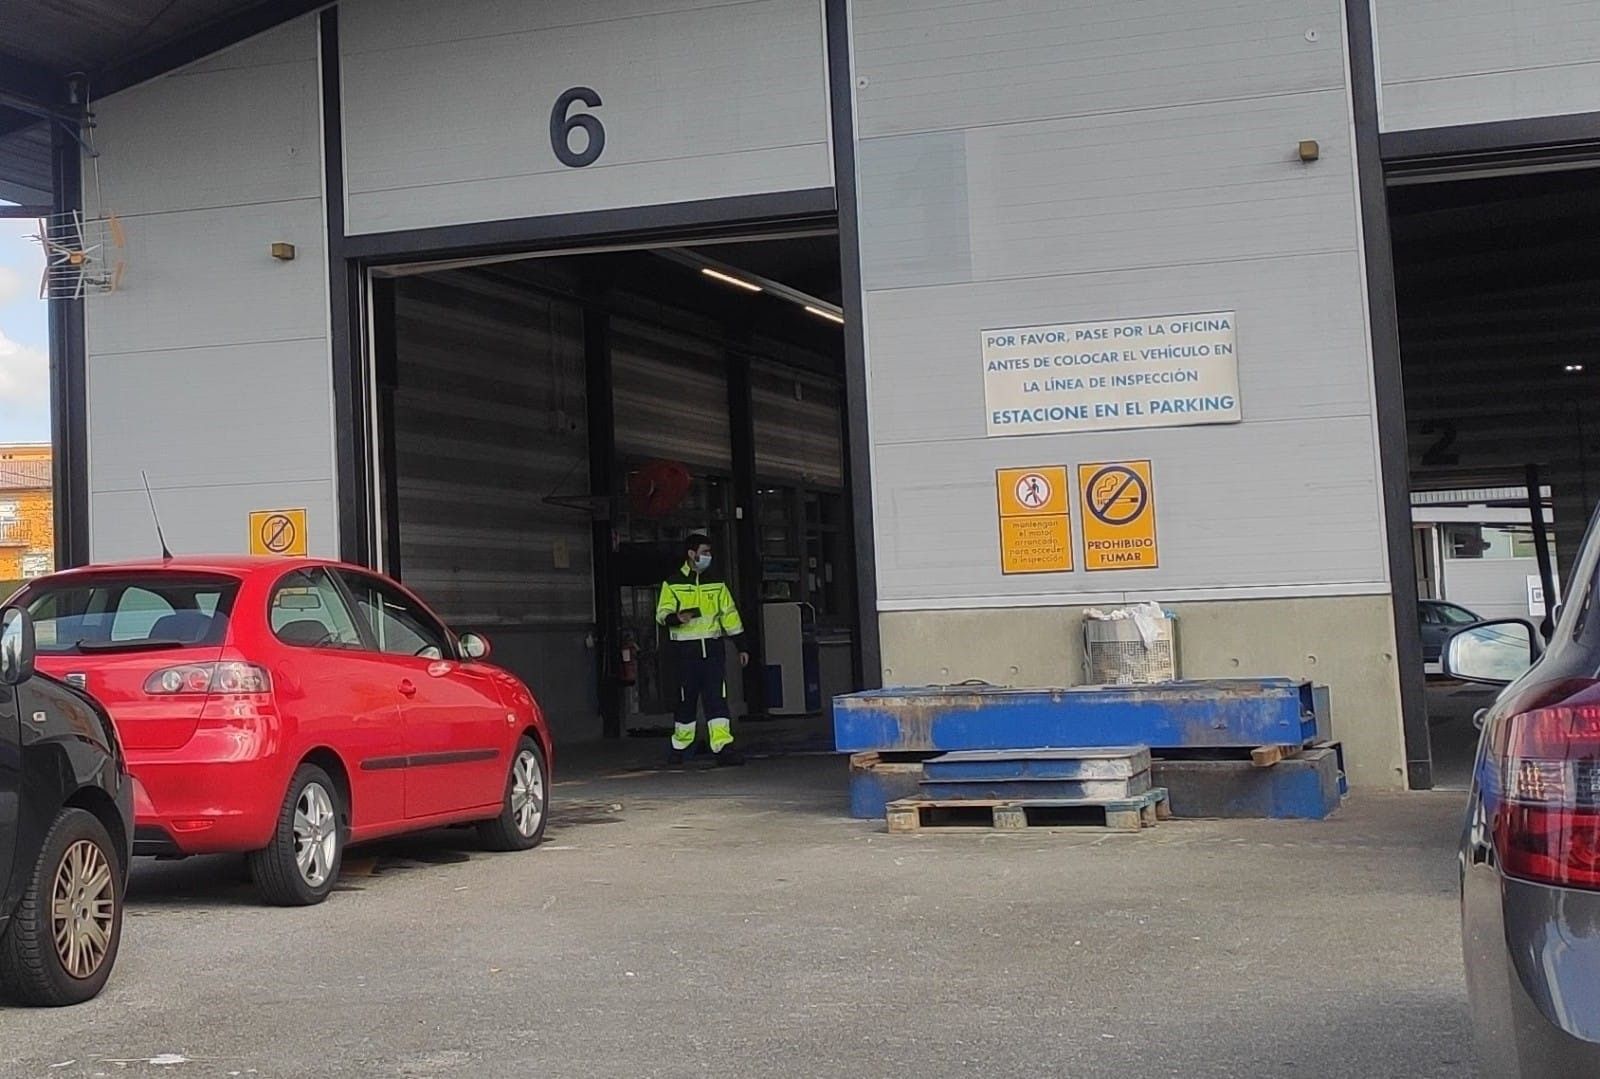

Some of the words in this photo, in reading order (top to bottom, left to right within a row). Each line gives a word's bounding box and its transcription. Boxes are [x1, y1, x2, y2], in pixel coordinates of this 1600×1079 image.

[550, 87, 605, 168] 6
[987, 336, 1016, 348] POR
[1021, 332, 1070, 345] FAVOR,
[1075, 329, 1108, 341] PASE
[1114, 326, 1143, 337] POR
[1148, 325, 1165, 335] LA
[1170, 319, 1230, 334] OFICINA
[987, 358, 1030, 371] ANTES
[1034, 357, 1050, 368] DE
[1053, 352, 1119, 366] COLOCAR
[1123, 350, 1138, 361] EL
[1141, 345, 1209, 360] VEHÍCULO
[1214, 344, 1232, 355] EN
[1023, 382, 1040, 393] LA
[1045, 377, 1084, 391] LÍNEA
[1089, 376, 1106, 388] DE
[1111, 368, 1198, 386] INSPECCIÓN
[992, 405, 1088, 425] ESTACIONE
[1095, 403, 1119, 417] EN
[1126, 401, 1144, 415] EL
[1150, 395, 1234, 414] PARKING
[1088, 538, 1153, 550] PROHIBIDO
[1101, 552, 1141, 563] FUMAR
